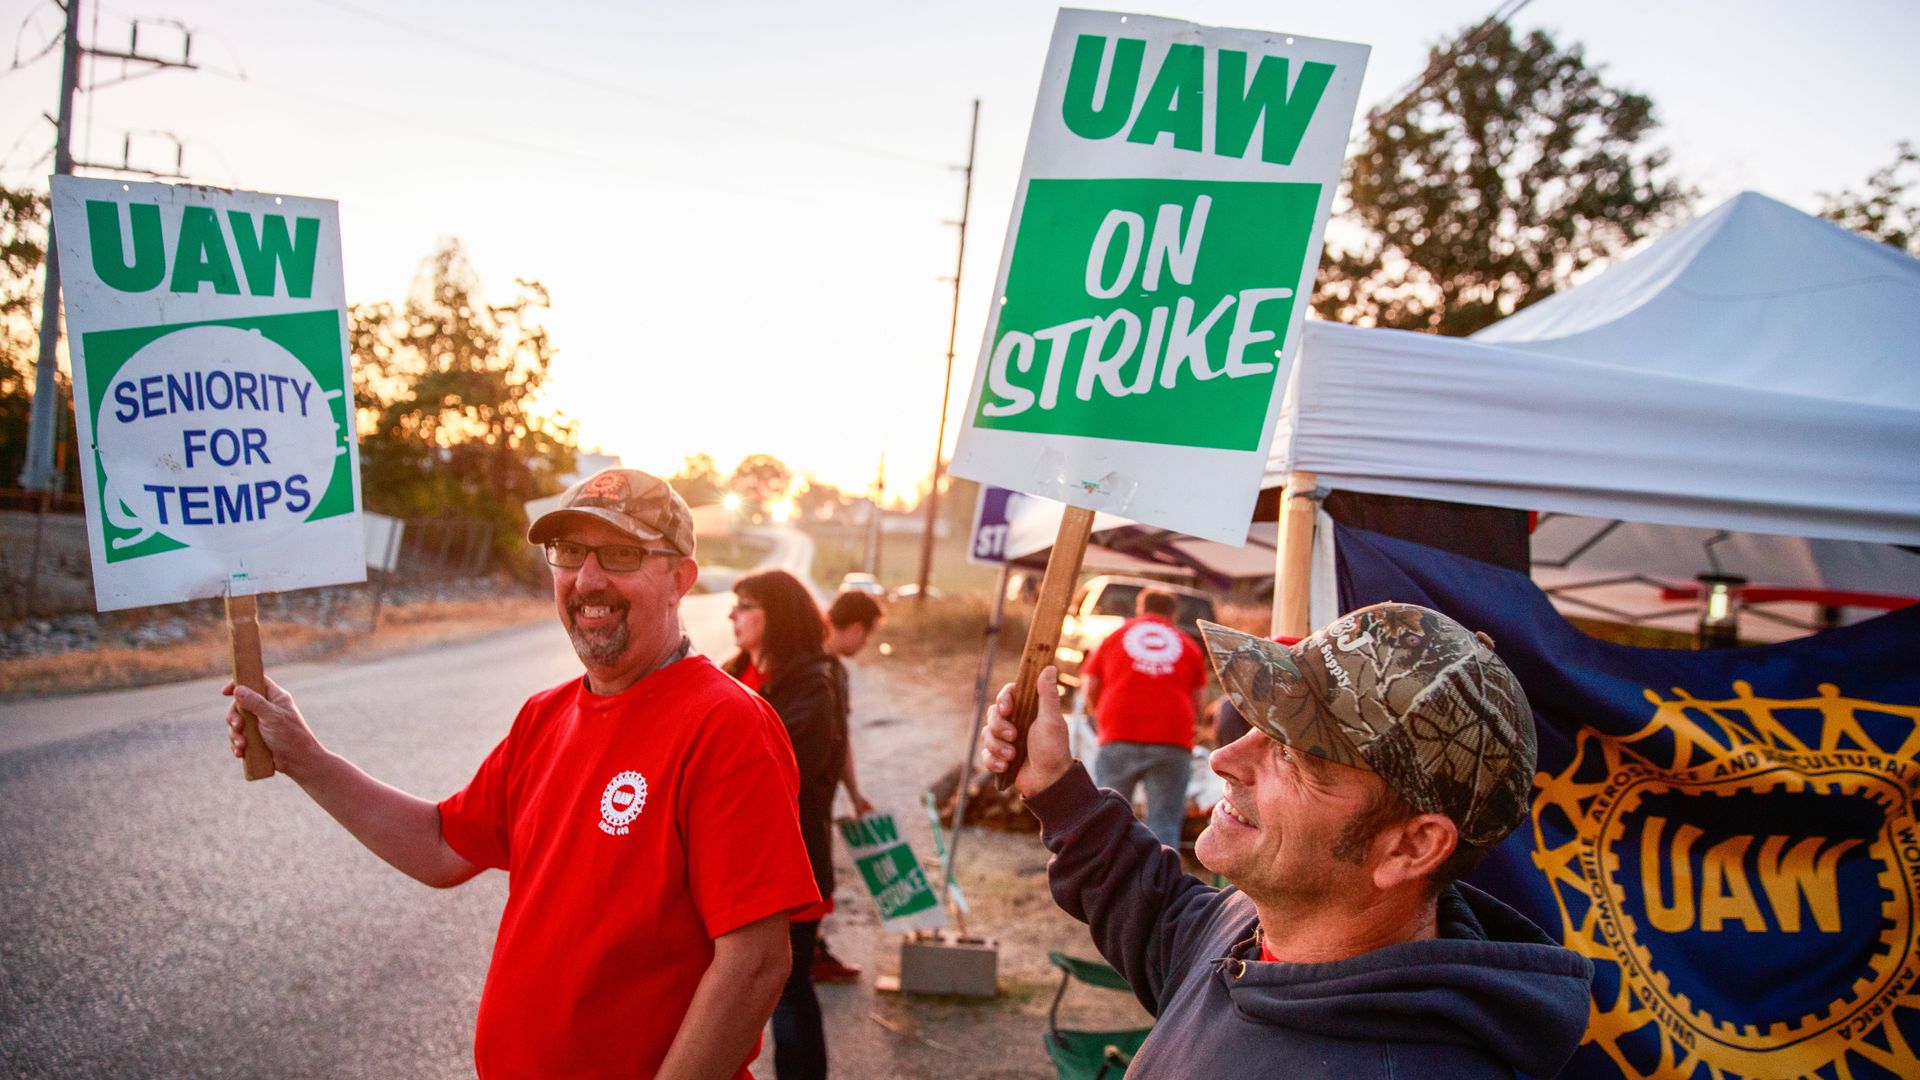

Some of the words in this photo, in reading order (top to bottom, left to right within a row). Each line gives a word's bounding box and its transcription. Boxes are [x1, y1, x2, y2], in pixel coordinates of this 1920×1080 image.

[1062, 34, 1336, 166] UAW
[85, 199, 320, 299] UAW
[1085, 194, 1212, 300] ON
[982, 287, 1293, 416] STRIKE
[114, 370, 312, 424] SENIORITY
[183, 428, 271, 469] FOR
[143, 474, 311, 526] TEMPS
[1321, 644, 1352, 687] Supply
[1592, 766, 1698, 823] AEROSCE
[1714, 751, 1759, 778] AND
[1762, 749, 1907, 779] CULTURAL
[1640, 815, 1866, 933] UAW
